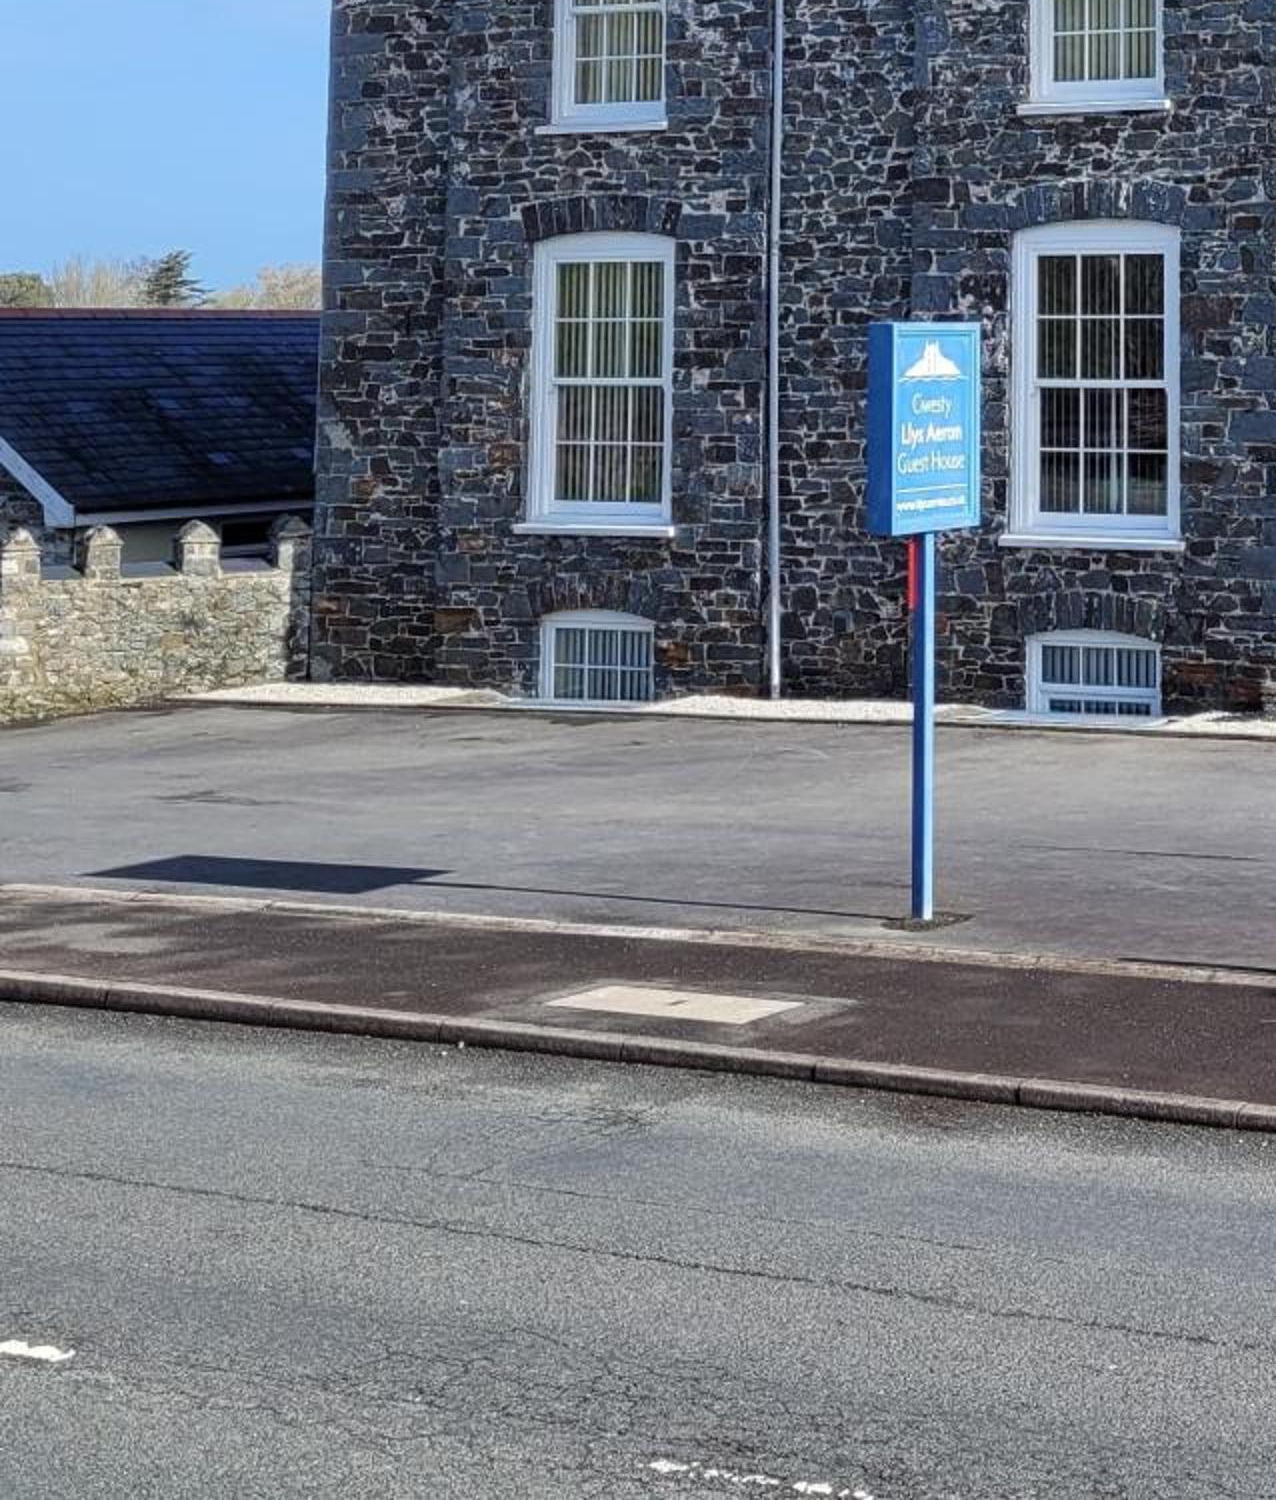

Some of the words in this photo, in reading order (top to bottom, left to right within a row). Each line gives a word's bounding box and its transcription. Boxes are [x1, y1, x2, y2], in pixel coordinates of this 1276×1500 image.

[901, 422, 924, 450] Llys
[926, 422, 962, 443] Aeron
[897, 453, 929, 474] Guest
[931, 451, 965, 470] House
